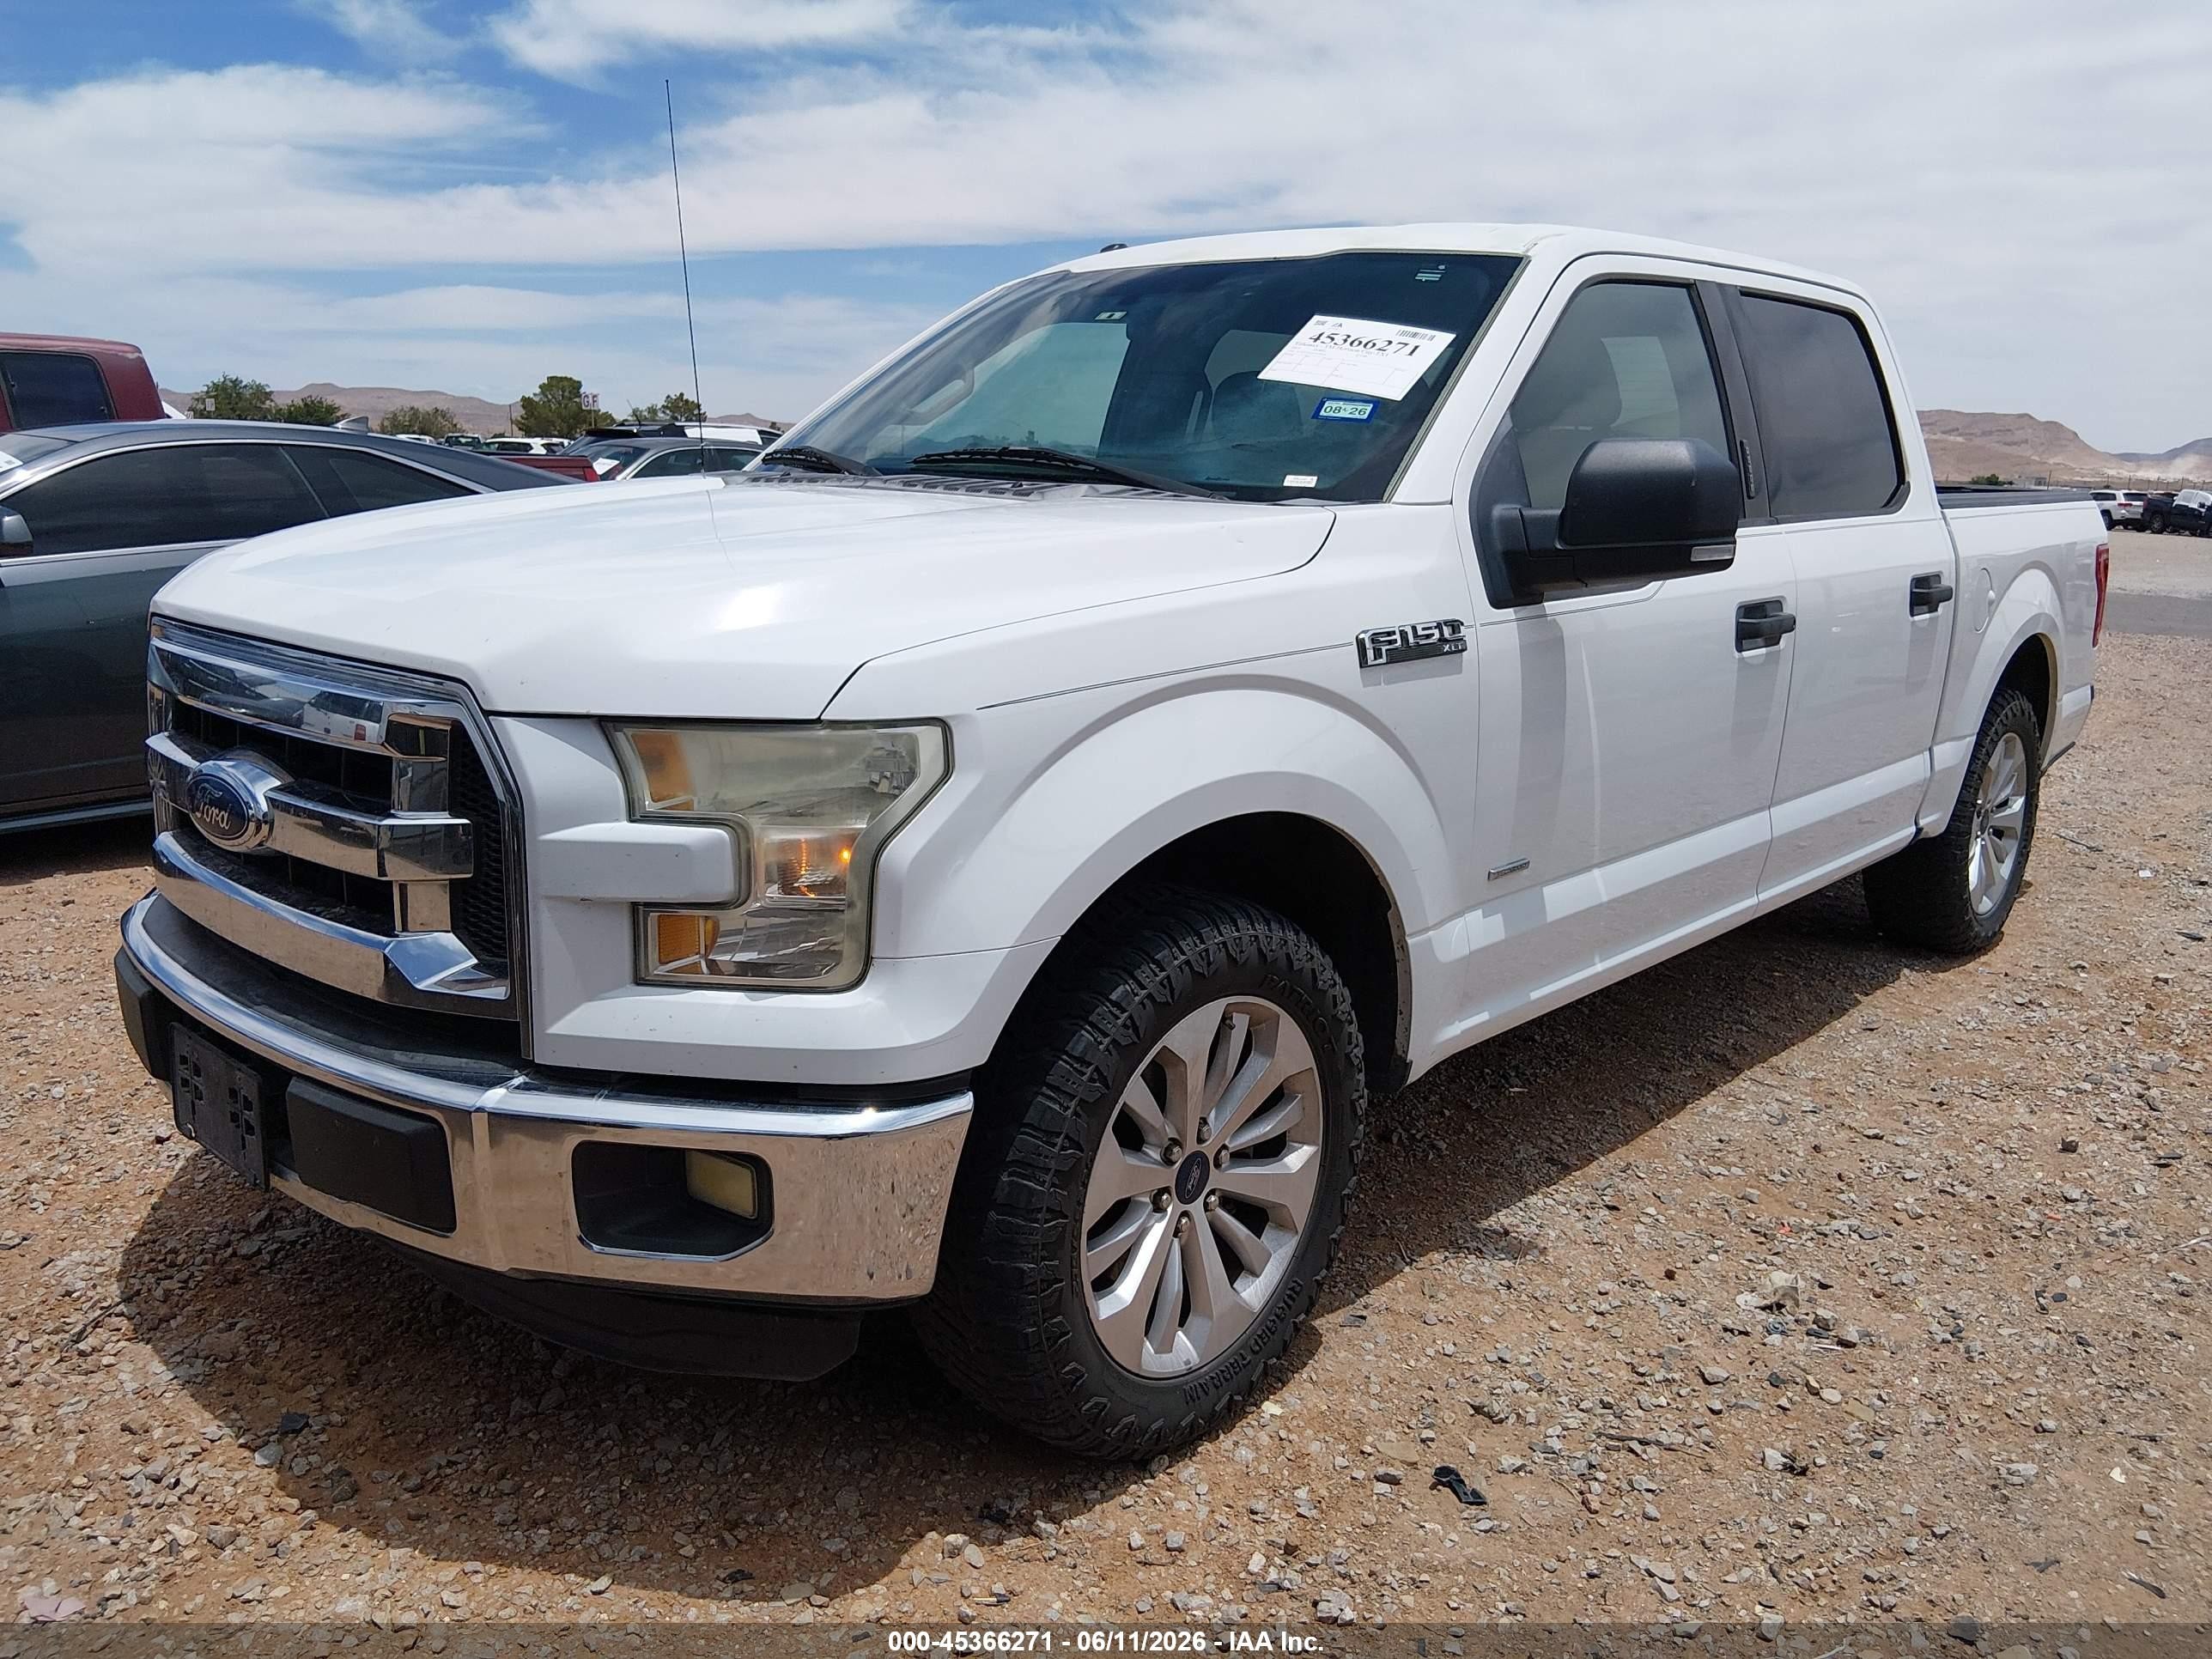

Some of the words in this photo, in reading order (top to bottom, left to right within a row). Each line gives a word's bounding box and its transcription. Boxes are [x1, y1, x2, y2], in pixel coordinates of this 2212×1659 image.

[1308, 331, 1422, 357] 45366271
[1323, 405, 1342, 415] 08
[1347, 406, 1369, 416] 26
[1443, 642, 1463, 653] XLT
[195, 782, 232, 831] Ford
[1249, 1277, 1304, 1355] RUGGED
[1182, 1352, 1251, 1405] TERRAIN
